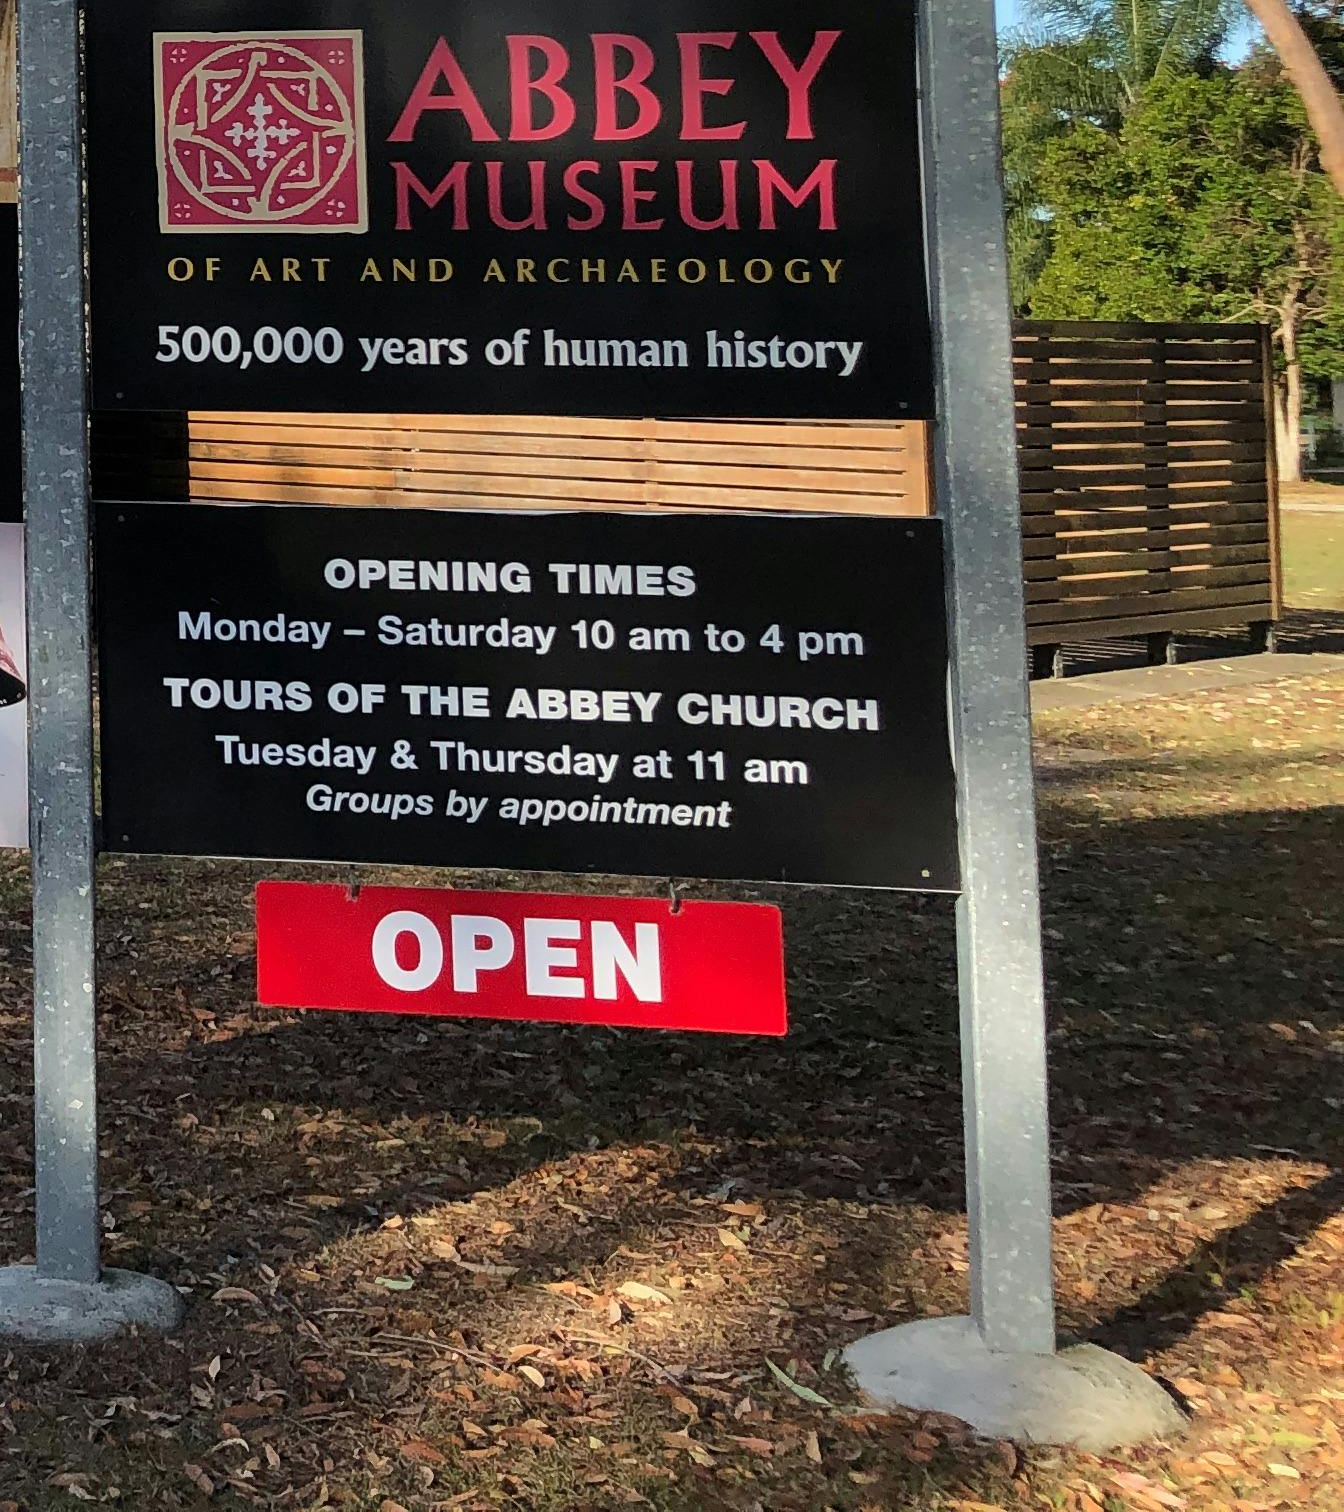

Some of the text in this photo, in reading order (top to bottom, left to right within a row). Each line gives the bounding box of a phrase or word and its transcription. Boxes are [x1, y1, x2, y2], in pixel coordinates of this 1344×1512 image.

[387, 30, 842, 143] ABBEY
[390, 158, 838, 231] MUSEUM
[167, 257, 843, 284] OF ART AND ARCHAEOLOGY
[155, 325, 864, 377] 500,000 years of human history
[323, 558, 696, 597] OPENING TIMES
[178, 610, 332, 650] Monday
[377, 615, 557, 655] Saturday
[570, 619, 615, 650] 10
[628, 627, 691, 652] am
[703, 623, 746, 653] to
[759, 623, 785, 654] 4
[798, 631, 864, 662] pm
[162, 677, 880, 731] TOURS OF THE ABBEY CHURCH
[214, 734, 809, 785] Tuesday & Thursday at 11 am
[306, 783, 733, 828] Groups by appointment
[371, 910, 663, 1003] OPEN
